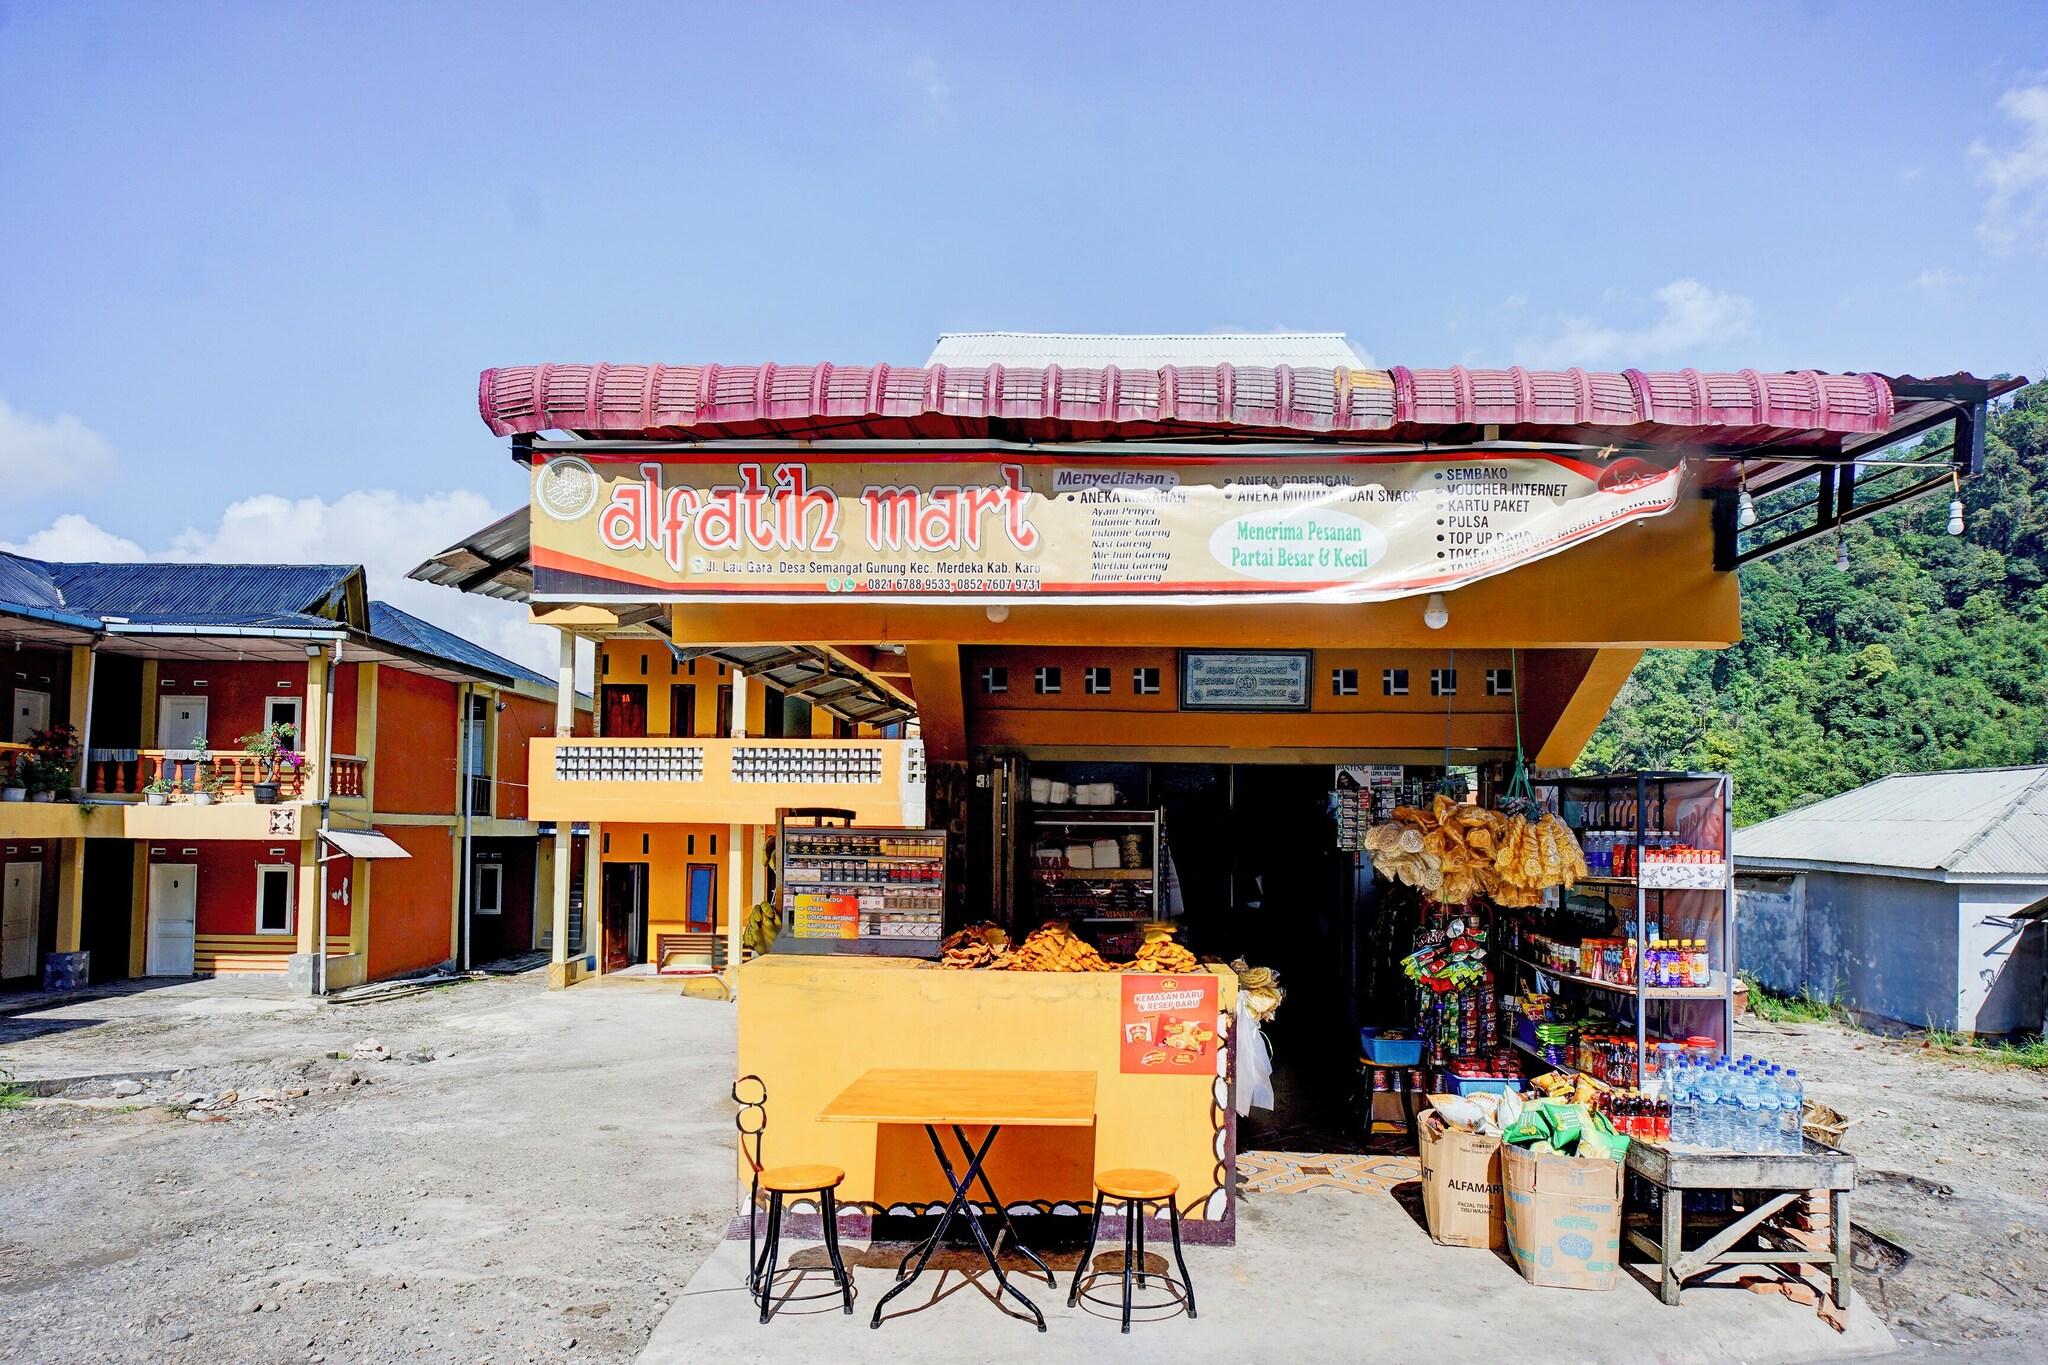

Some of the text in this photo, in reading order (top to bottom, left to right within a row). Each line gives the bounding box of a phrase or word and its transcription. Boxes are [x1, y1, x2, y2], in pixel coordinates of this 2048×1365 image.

[1057, 471, 1165, 487] Menyediakan
[1237, 475, 1278, 486] ANEKA
[1446, 468, 1508, 481] SEMBAKO
[1080, 490, 1121, 504] ANEKA
[1238, 489, 1278, 502] ANEKA
[1350, 490, 1374, 502] DAN
[1378, 490, 1420, 502] SNACK
[1447, 483, 1568, 497] VOUCHER INTERNET
[1091, 507, 1119, 516] Ayam
[1448, 499, 1530, 513] KARTU PAKET
[599, 463, 838, 570] alfatih
[861, 463, 1041, 552] mart
[1448, 515, 1489, 528] PULSA
[1236, 521, 1362, 541] Menerima Pesanan
[1448, 531, 1473, 545] TOP
[1477, 531, 1493, 545] UP
[1231, 547, 1369, 568] Partai Besar & Kecil
[706, 561, 718, 573] Jl.
[723, 561, 742, 573] Lau
[780, 561, 805, 574] Desa
[809, 561, 862, 575] Semangat
[866, 561, 906, 576] Gunung
[910, 561, 932, 574] Kec.
[937, 561, 983, 574] Merdeka
[987, 562, 1011, 574] Kab.
[1015, 562, 1041, 574] Karo
[868, 578, 1041, 592] 0821 6788 9533, 0852 7607 9731
[1135, 991, 1203, 1003] KEMASAN BARU
[1147, 1001, 1174, 1010] RESEP
[1175, 1000, 1199, 1008] BARU
[1457, 1200, 1476, 1209] FACIAL
